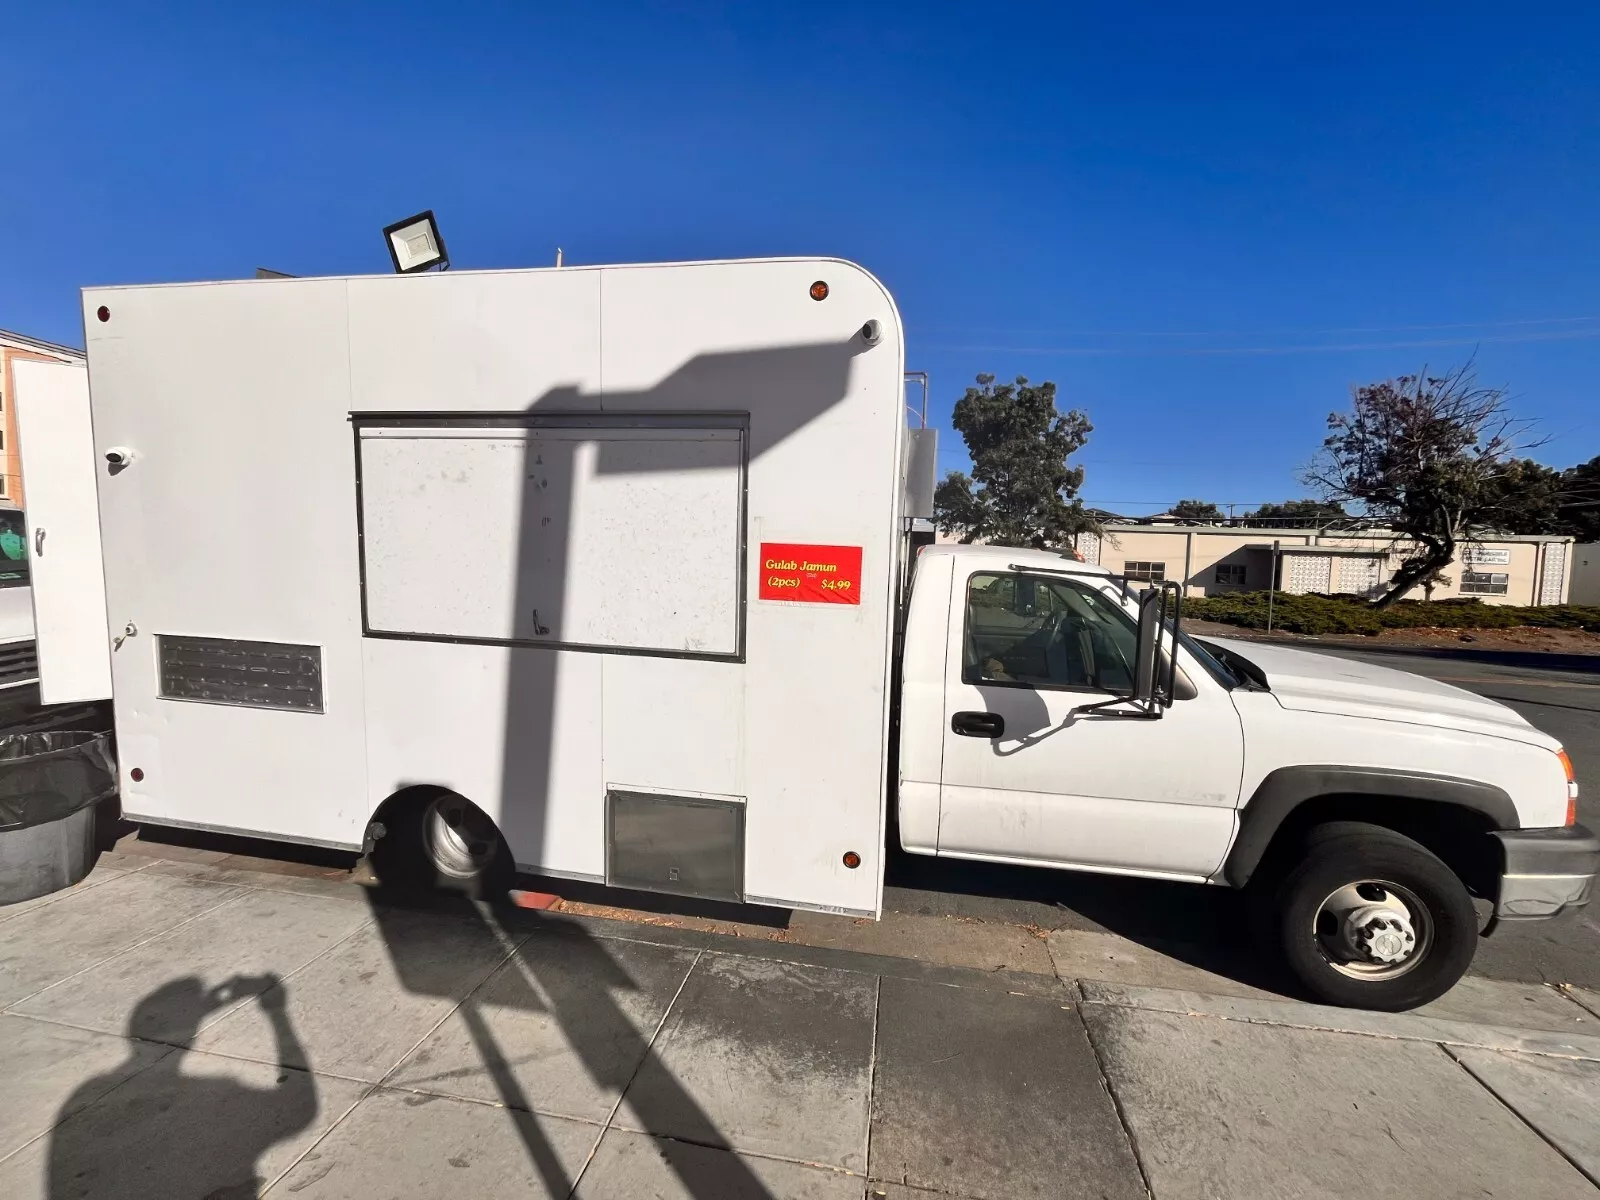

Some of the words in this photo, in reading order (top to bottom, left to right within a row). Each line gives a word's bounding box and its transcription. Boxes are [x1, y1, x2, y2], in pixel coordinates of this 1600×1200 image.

[766, 559, 797, 570] Gulab
[800, 561, 837, 572] Jamun
[768, 576, 800, 588] (2pcs)
[821, 579, 851, 590] $4.99
